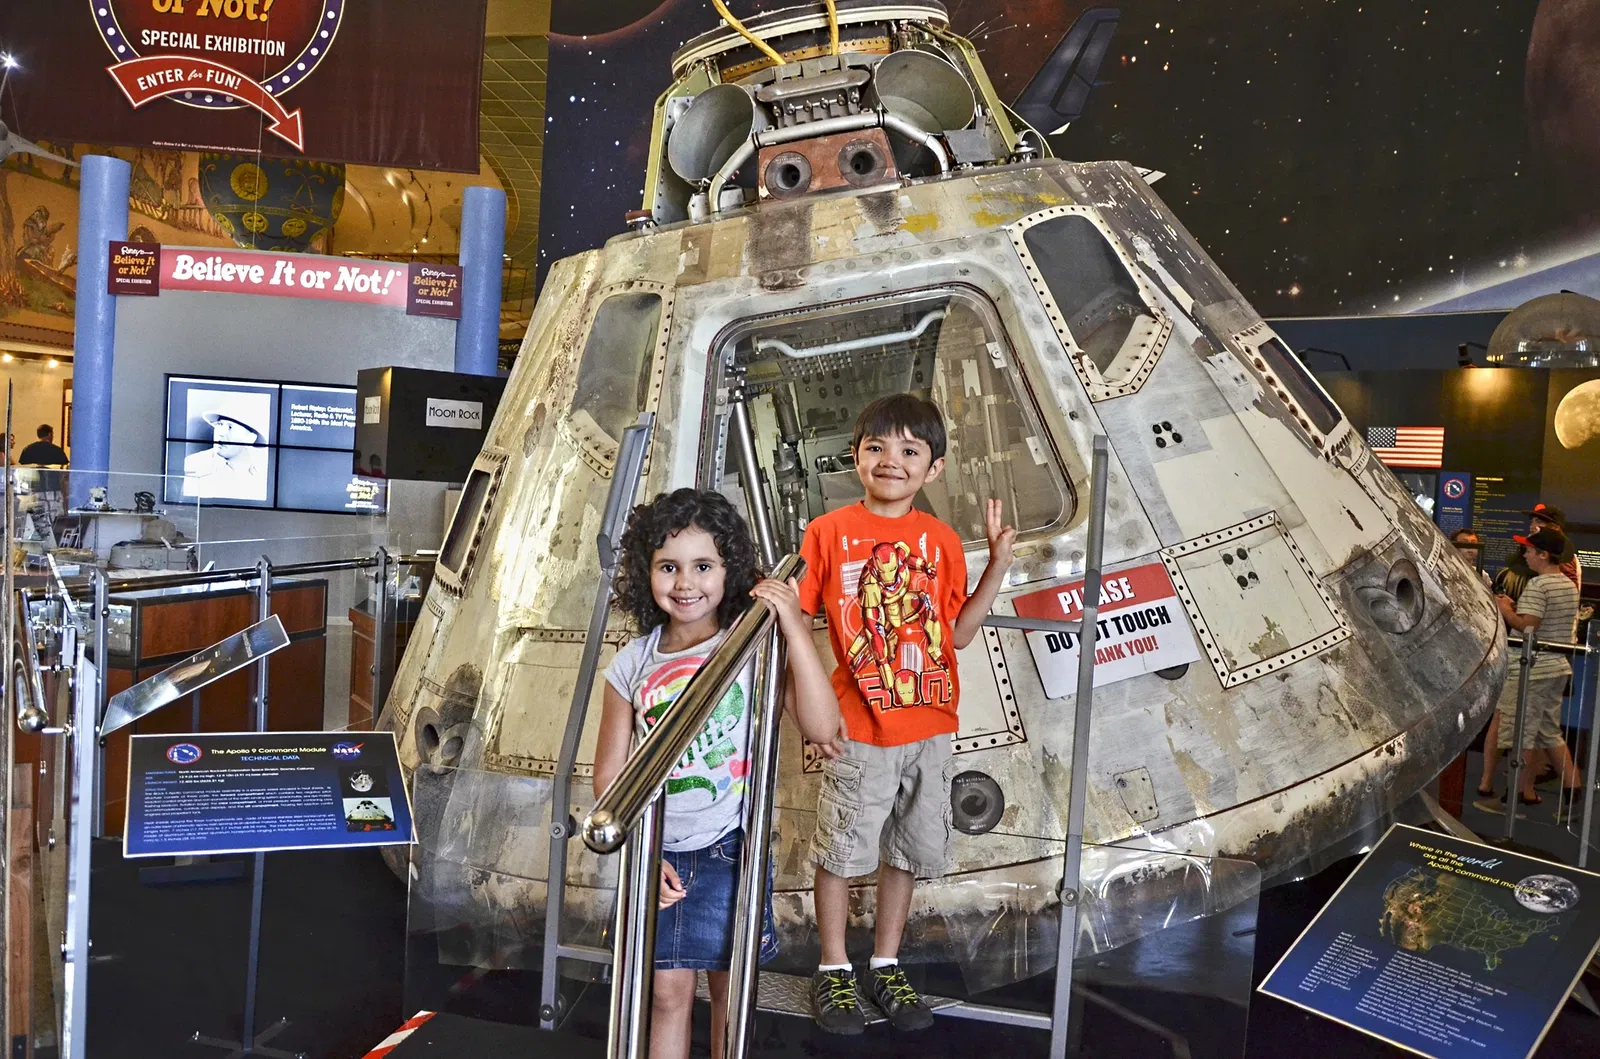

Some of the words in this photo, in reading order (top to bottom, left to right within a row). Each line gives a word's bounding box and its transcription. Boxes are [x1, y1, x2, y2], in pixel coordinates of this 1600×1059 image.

[196, 0, 274, 21] Not!
[141, 29, 200, 49] SPECIAL
[205, 35, 285, 56] EXHIBITION
[137, 68, 184, 91] ENTER
[188, 69, 202, 81] for
[206, 69, 241, 90] FUN!
[113, 255, 145, 265] Believe
[147, 257, 156, 265] It
[129, 266, 149, 275] Not!
[172, 254, 264, 284] Believe
[269, 260, 296, 285] It
[300, 268, 332, 289] or
[333, 265, 396, 296] Not!
[413, 275, 447, 287] Believe
[448, 279, 457, 288] It
[430, 287, 451, 297] Not!
[428, 406, 456, 418] MOON
[459, 409, 480, 420] ROCK
[1057, 577, 1136, 615] PLASE
[1044, 631, 1074, 654] DO
[1110, 605, 1172, 636] TOUCH
[1077, 643, 1127, 666] ANK
[1124, 635, 1159, 657] YOU!
[333, 748, 361, 756] NASA
[1409, 841, 1434, 853] Where
[1444, 850, 1458, 859] the
[1457, 855, 1503, 870] world
[1423, 852, 1437, 860] are
[1450, 858, 1464, 867] the
[1427, 860, 1454, 872] Apollo
[1455, 866, 1500, 884] command
